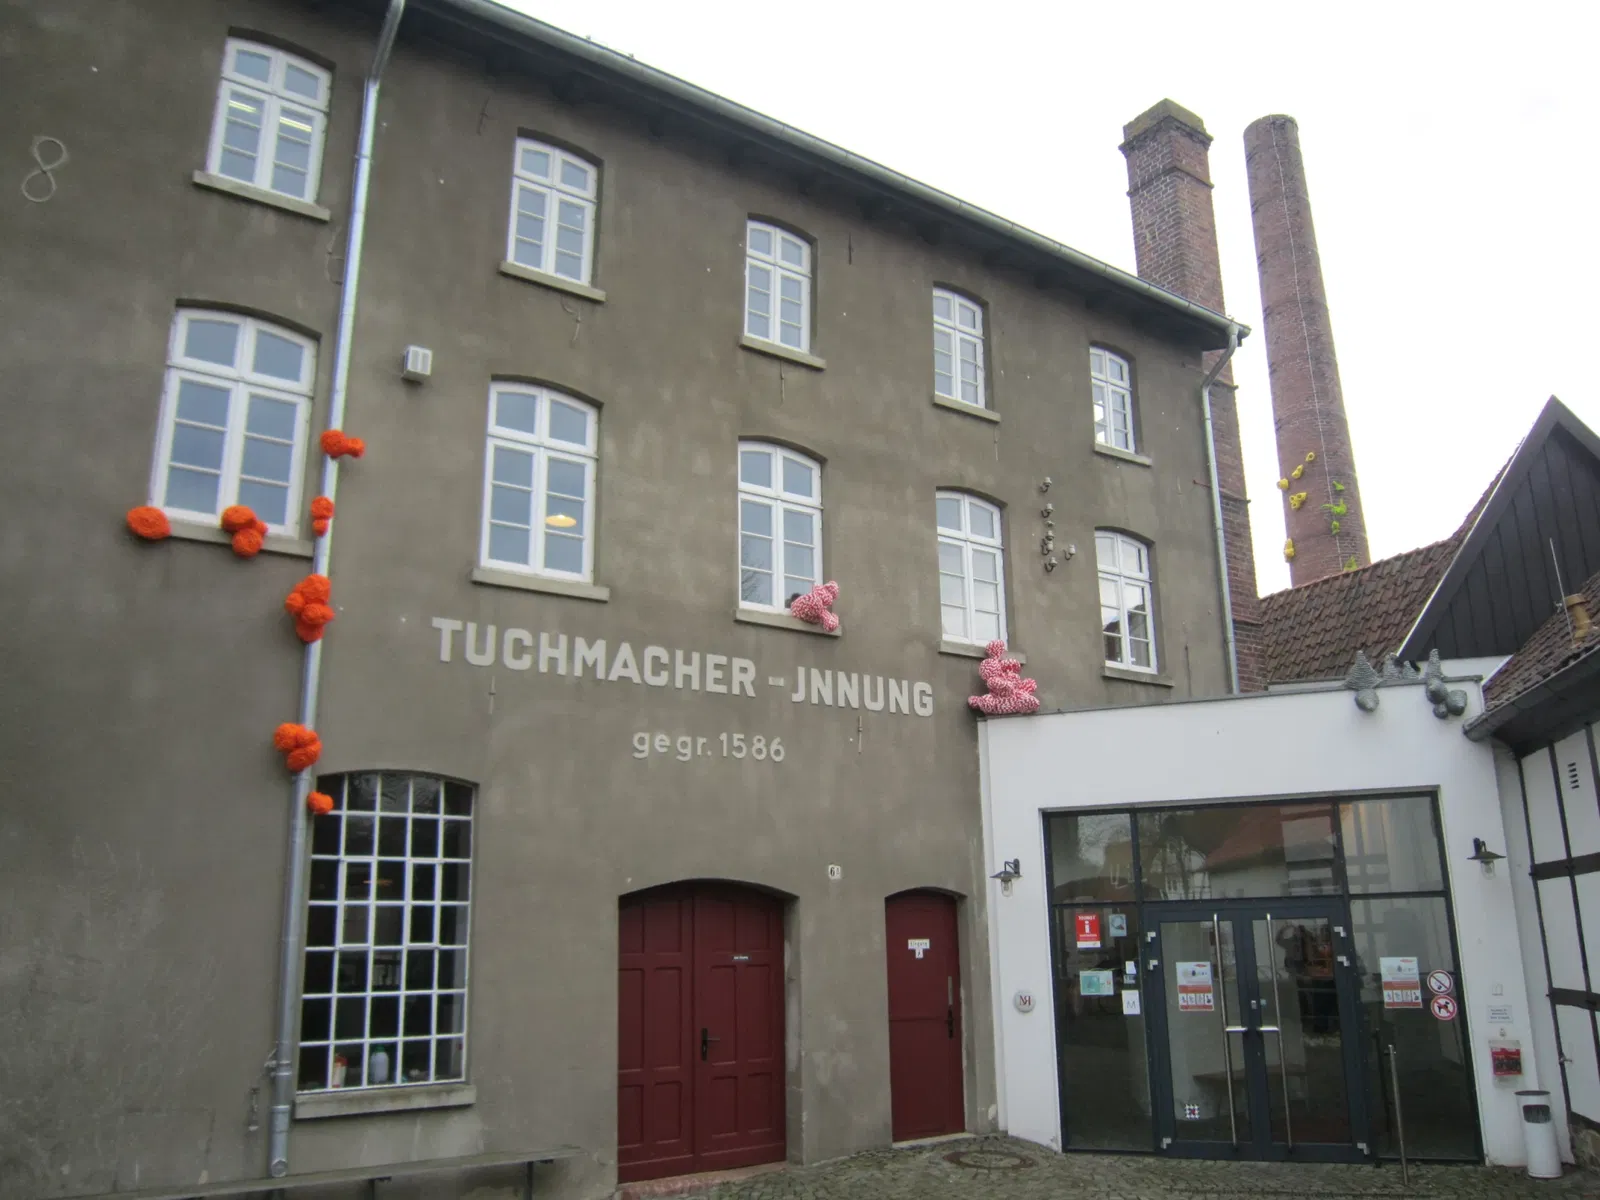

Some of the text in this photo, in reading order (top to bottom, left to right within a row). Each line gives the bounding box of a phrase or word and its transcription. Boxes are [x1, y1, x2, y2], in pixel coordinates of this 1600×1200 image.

[431, 616, 757, 698] TUCHMACHER
[632, 731, 785, 762] gegr. 1586
